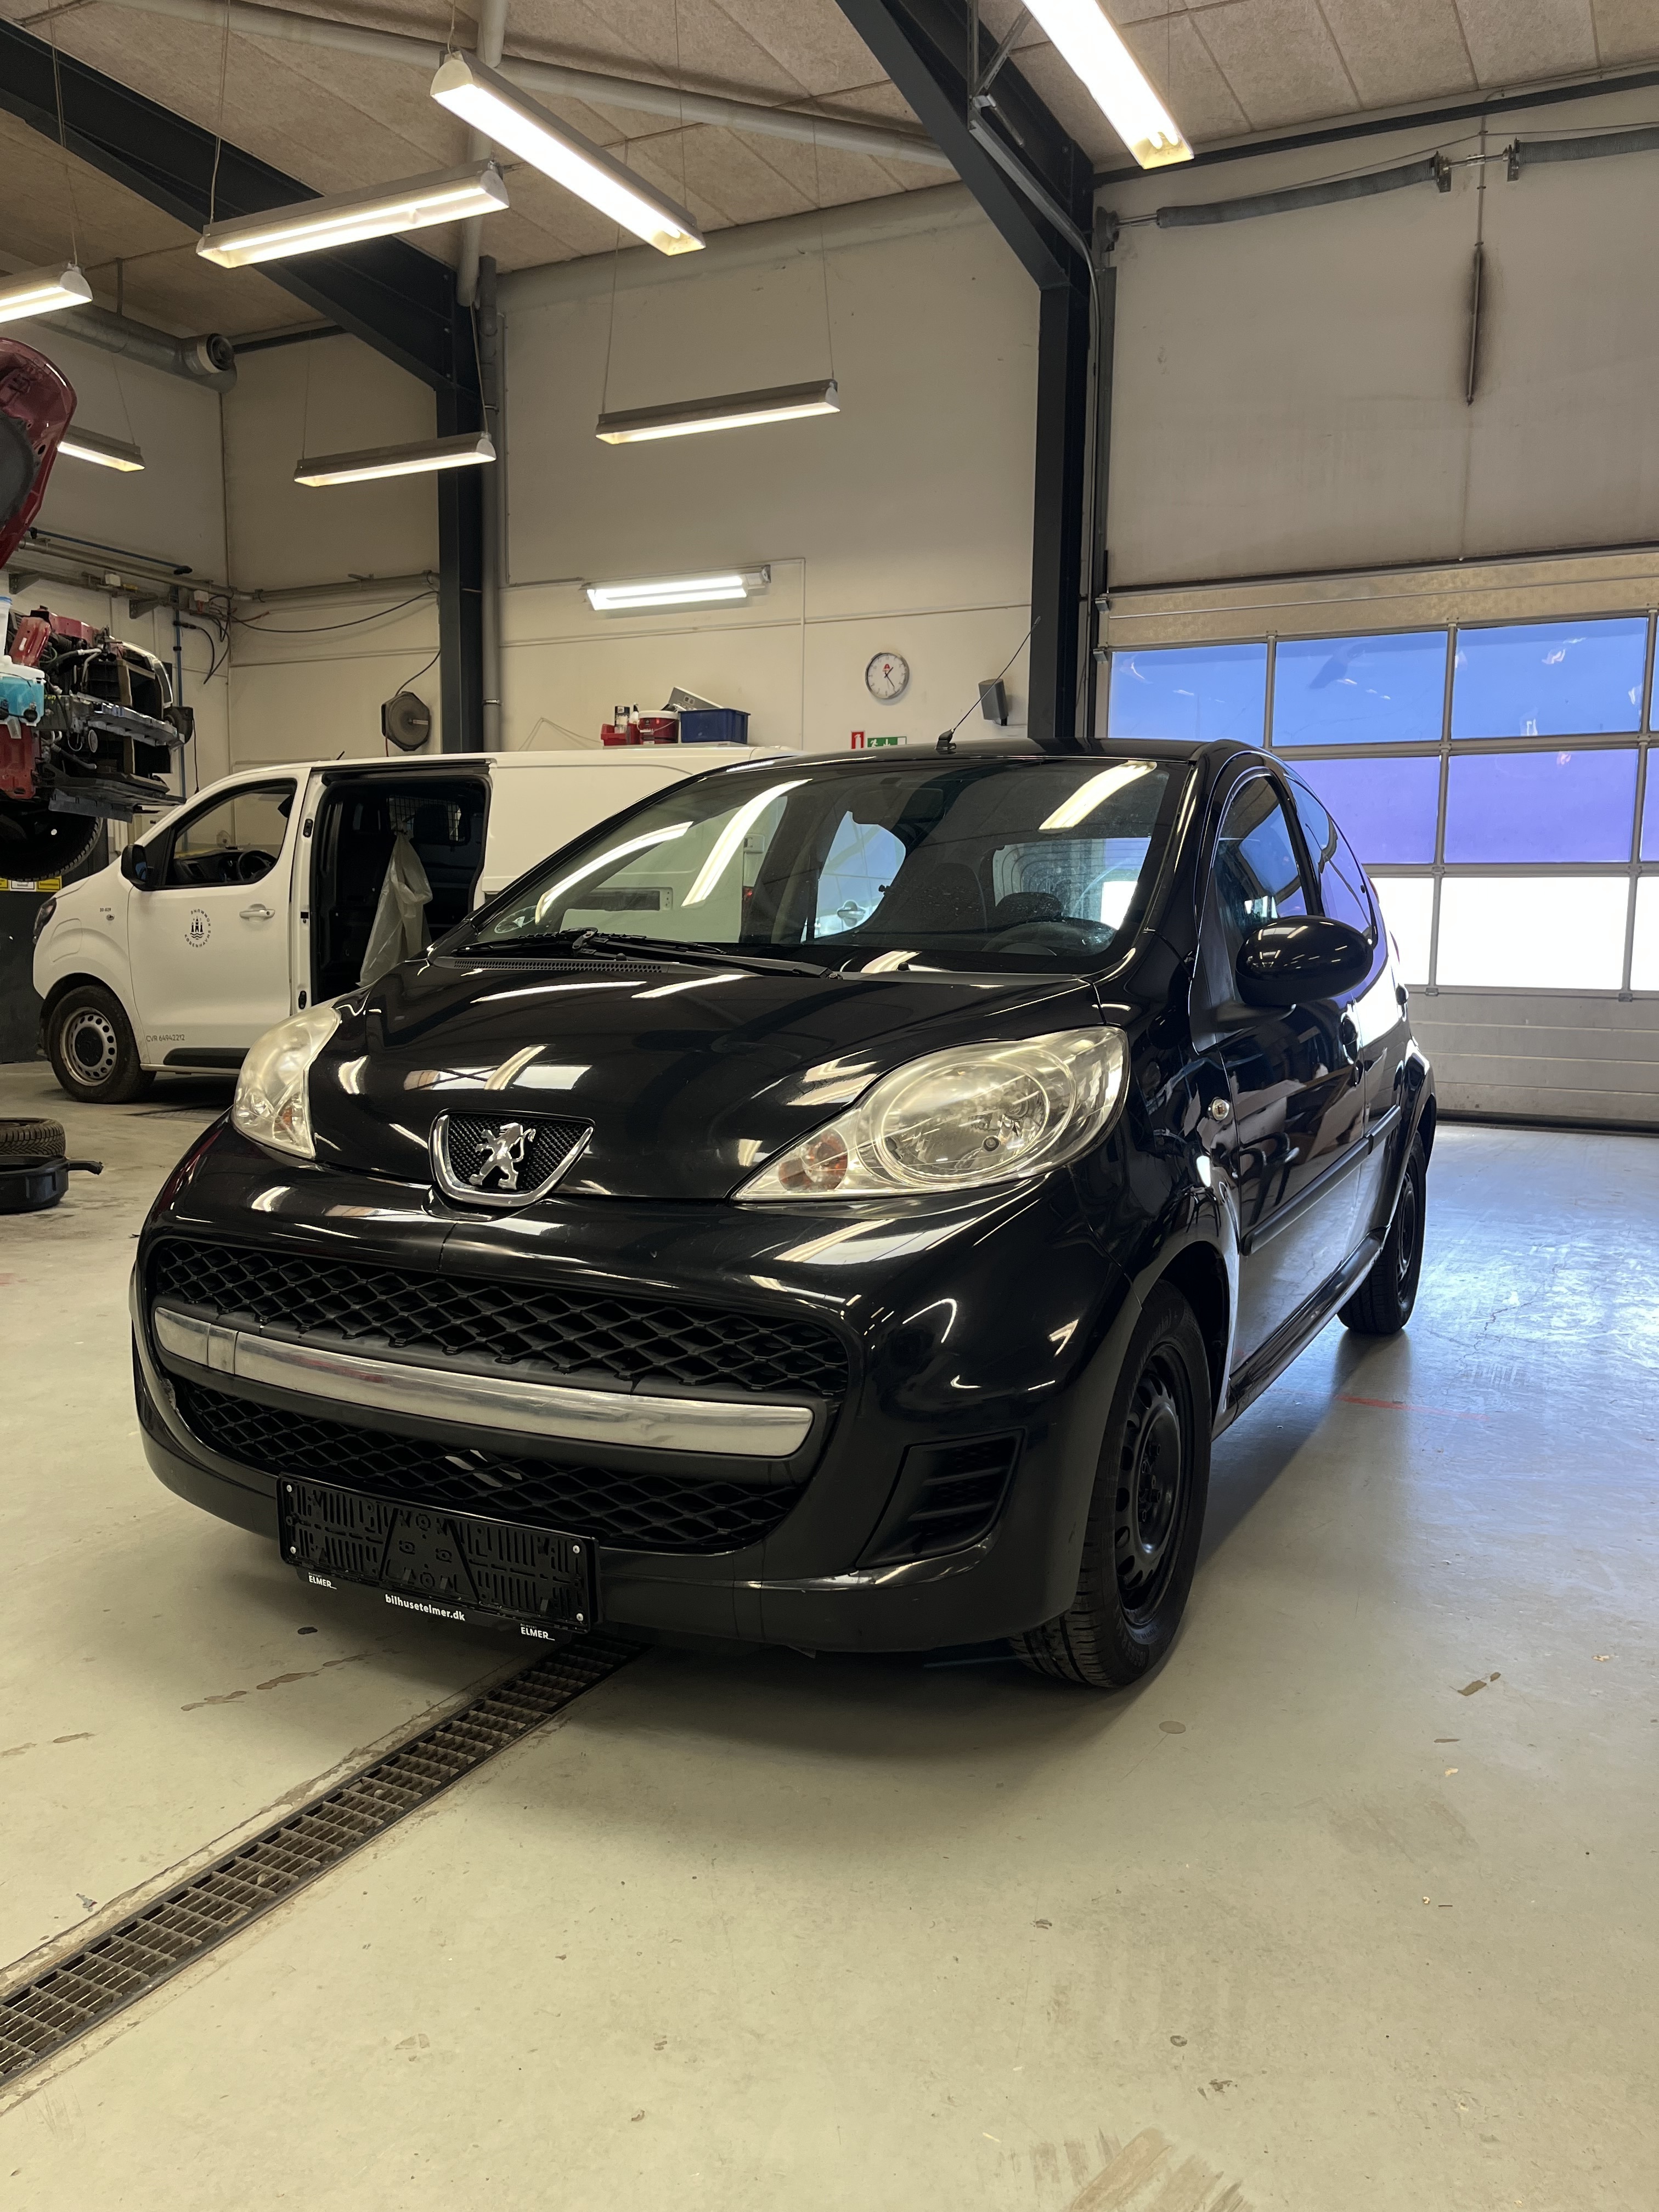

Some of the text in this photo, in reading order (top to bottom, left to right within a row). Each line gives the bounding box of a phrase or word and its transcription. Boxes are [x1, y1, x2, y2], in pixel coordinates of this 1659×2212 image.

[159, 1034, 185, 1042] 64942212
[308, 1575, 336, 1589] ELMER
[385, 1594, 466, 1621] bilhusetelmer.dk
[521, 1626, 555, 1641] ELMER
